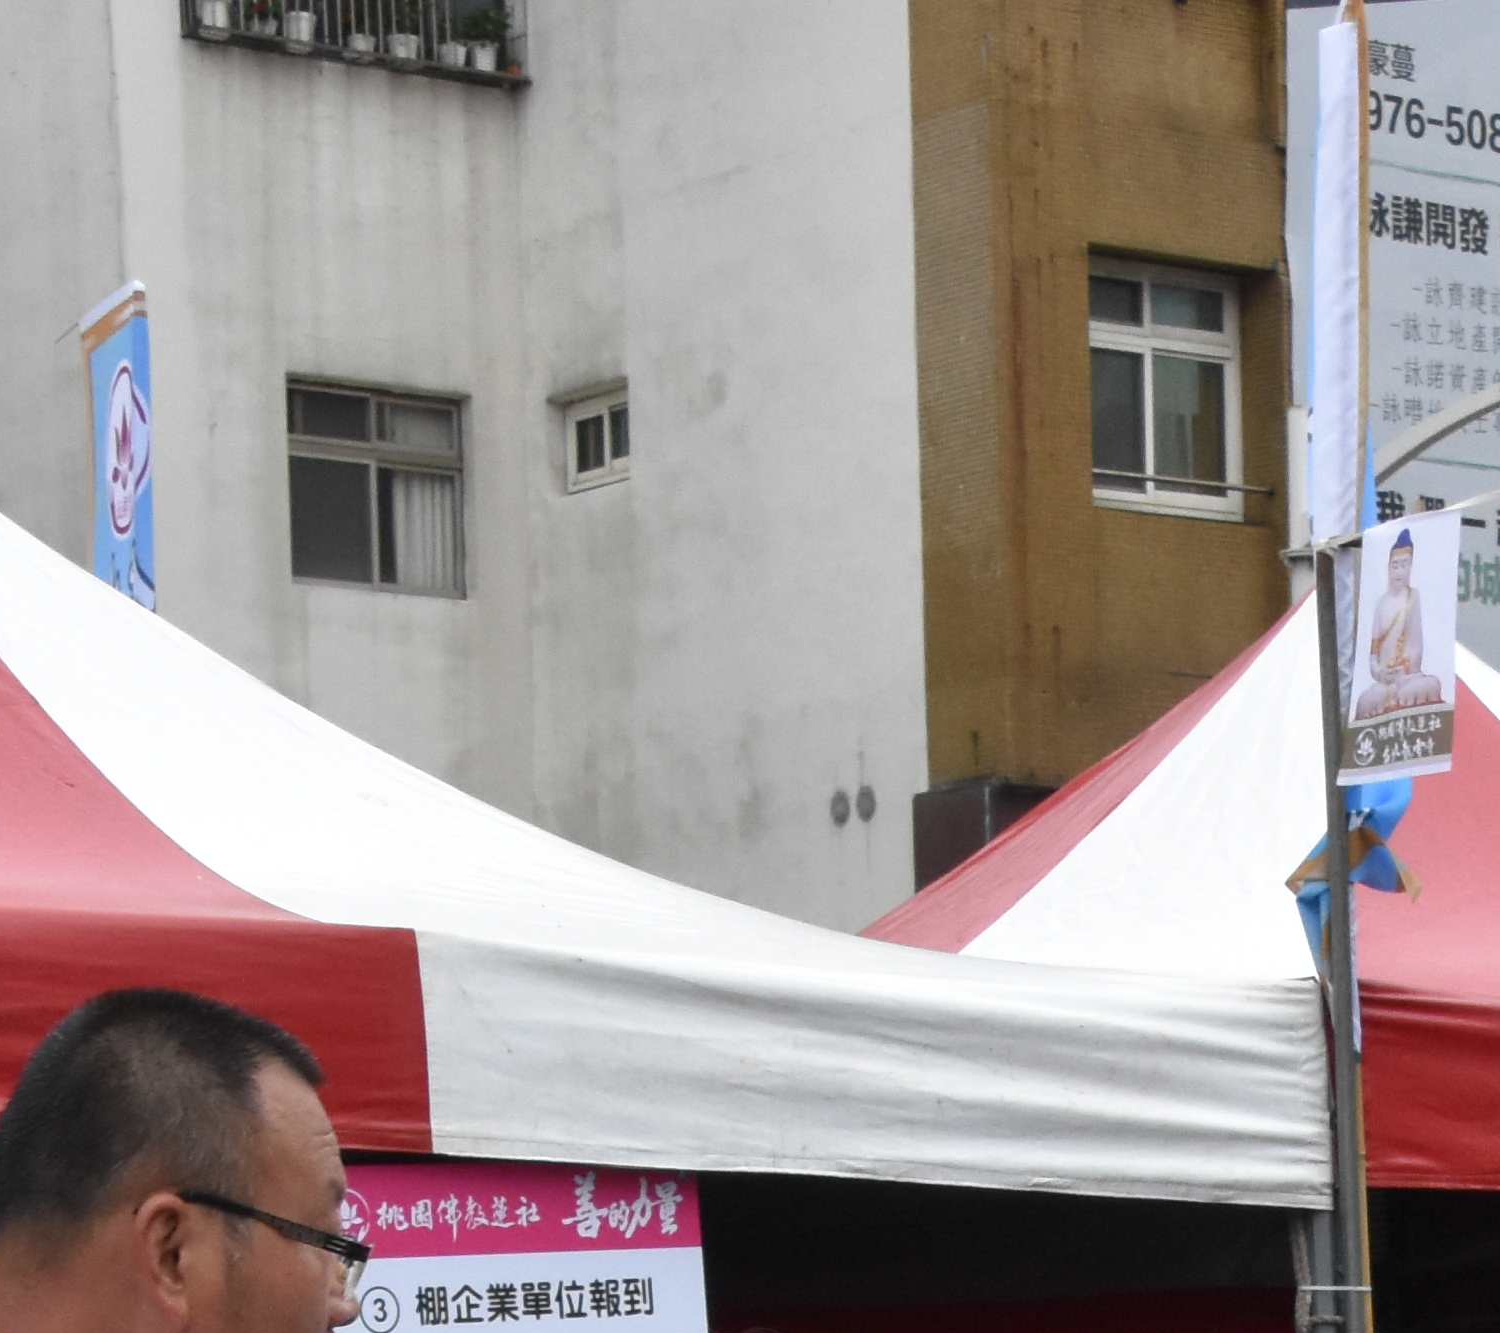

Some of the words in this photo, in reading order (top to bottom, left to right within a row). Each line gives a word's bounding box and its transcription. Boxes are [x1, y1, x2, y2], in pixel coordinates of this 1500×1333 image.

[376, 1193, 541, 1242] 桃園佛教蓮社
[562, 1170, 684, 1239] 善的力量
[415, 1276, 655, 1327] 棚企業單位報到
